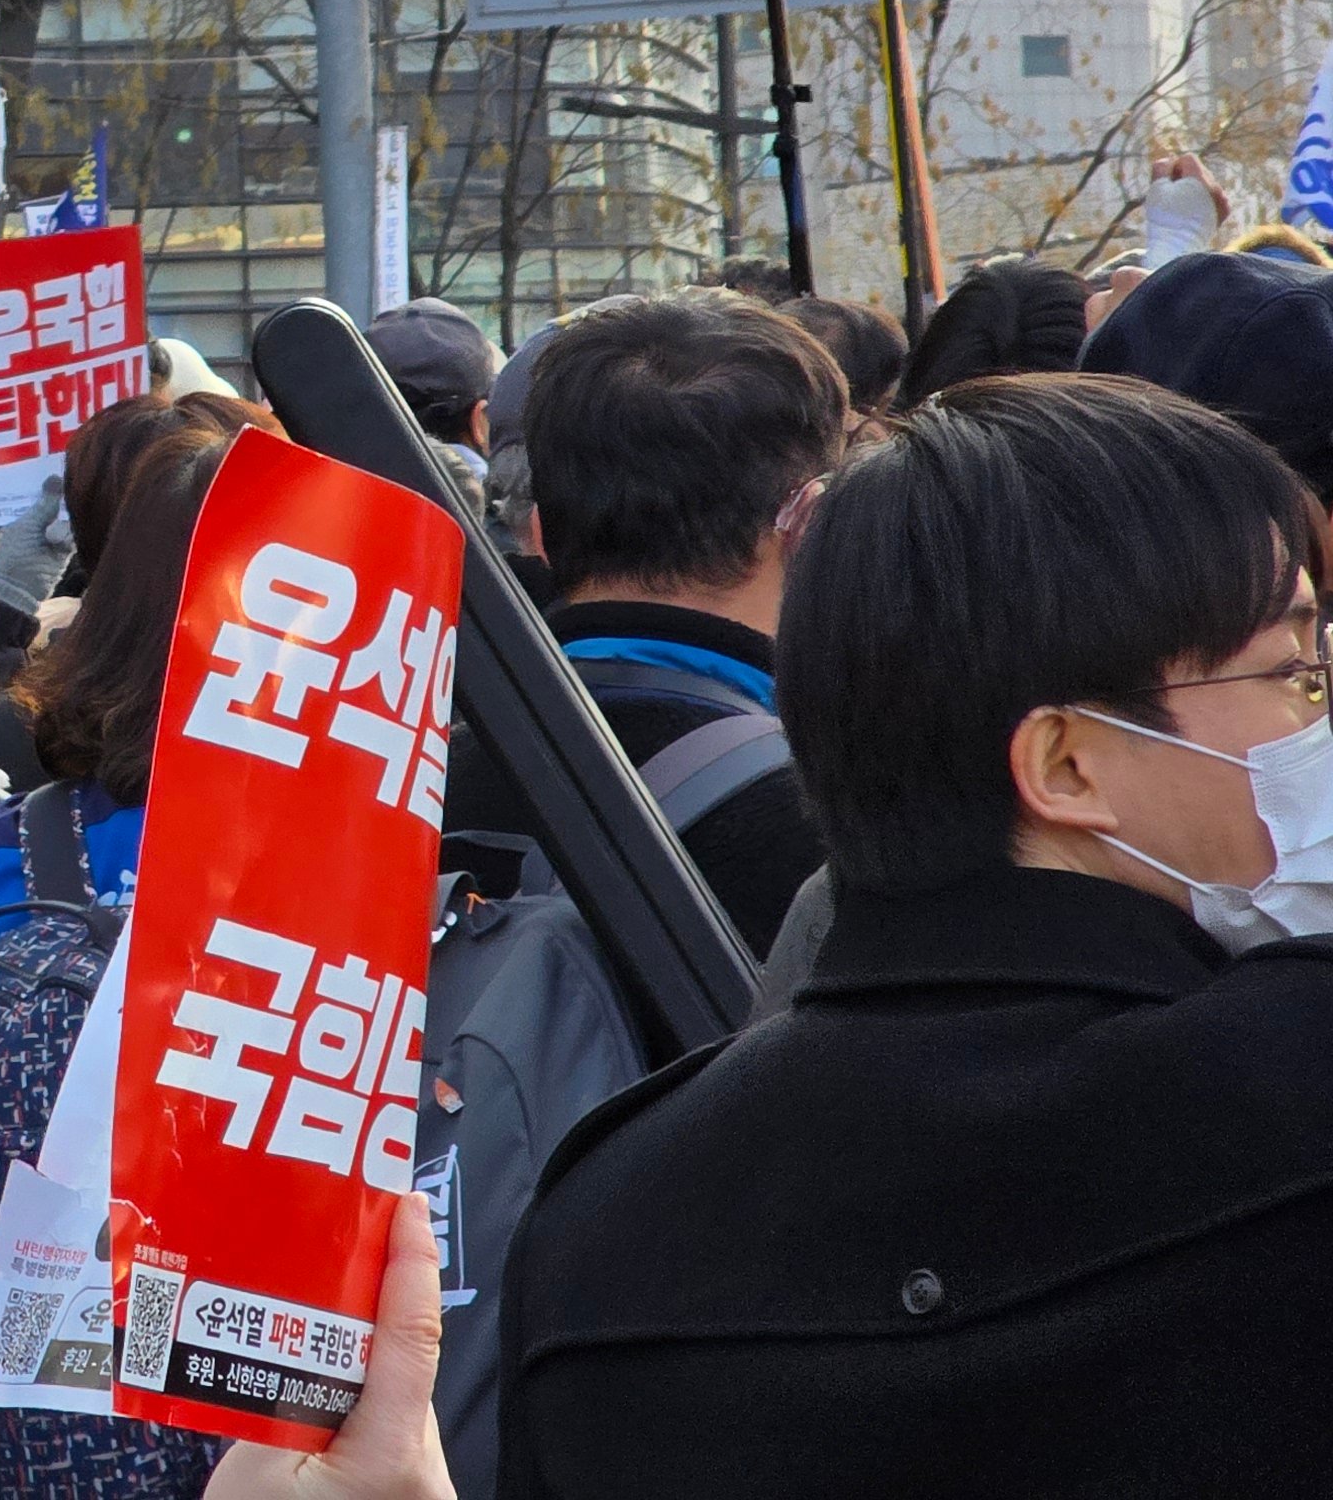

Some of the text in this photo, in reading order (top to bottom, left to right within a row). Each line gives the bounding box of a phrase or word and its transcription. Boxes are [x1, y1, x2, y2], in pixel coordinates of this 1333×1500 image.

[268, 1312, 307, 1358] 파면
[309, 1321, 357, 1370] 국힘당
[186, 1353, 216, 1387] 후원
[226, 1362, 282, 1401] 신한은행
